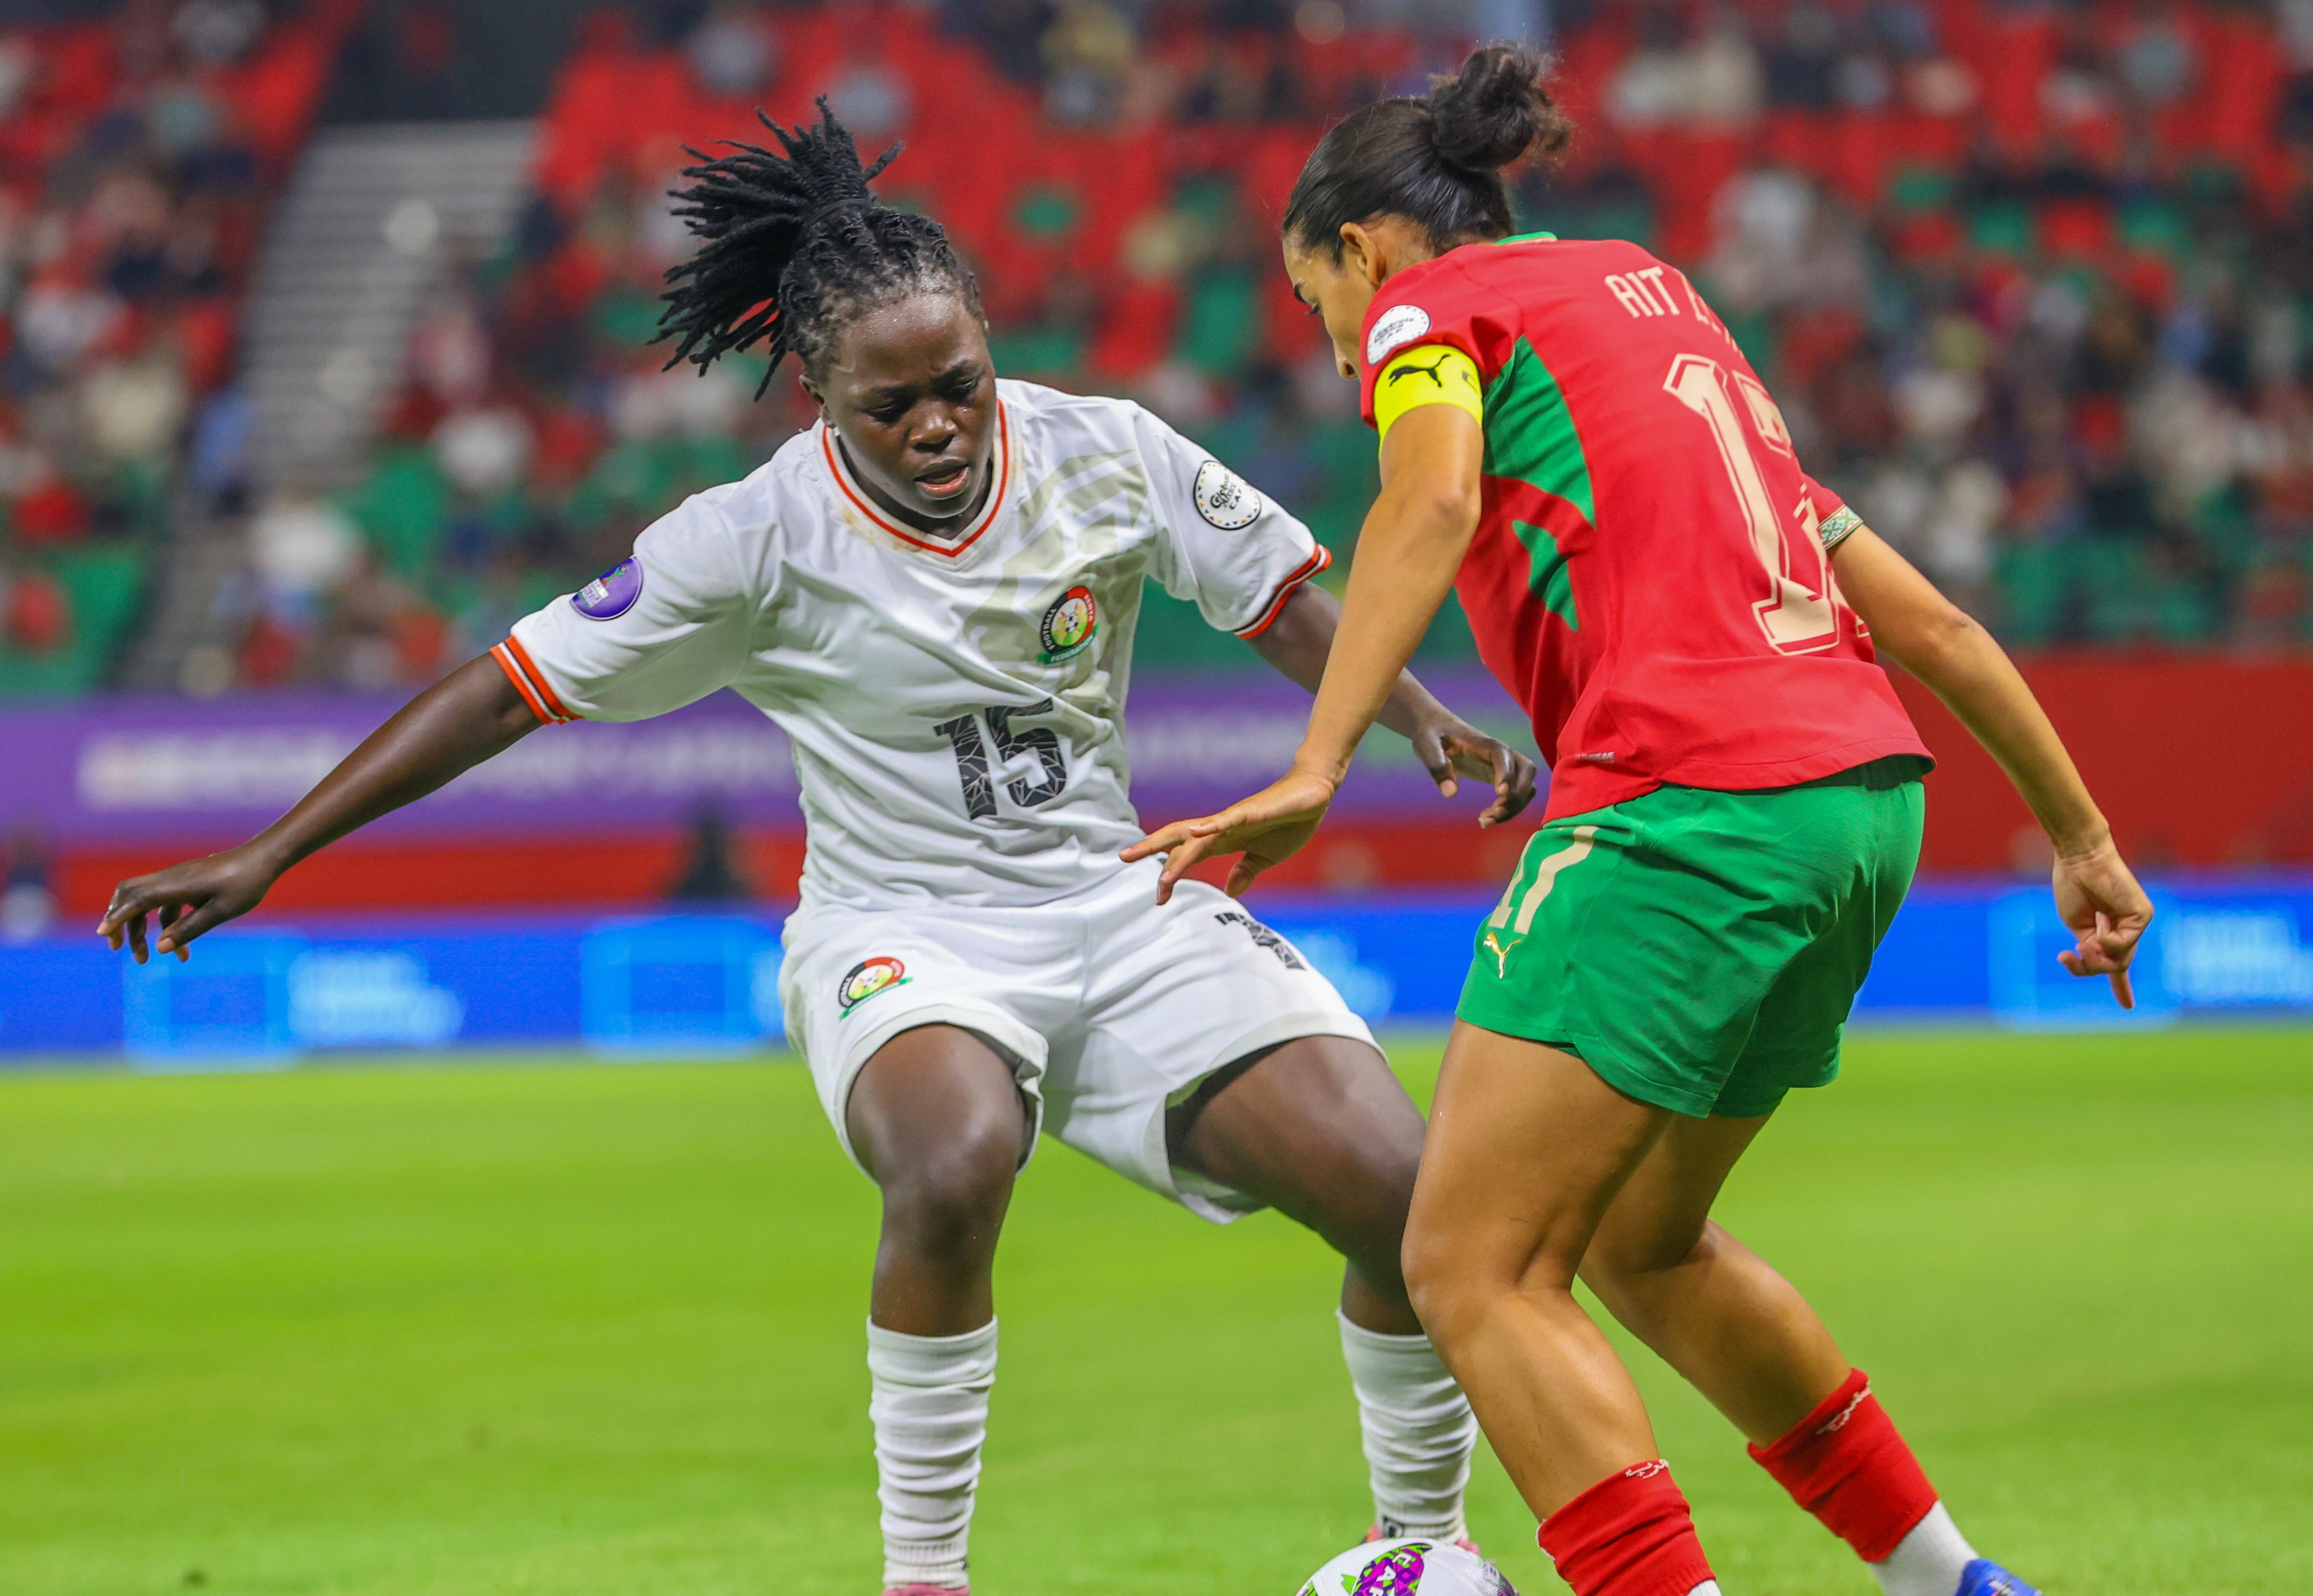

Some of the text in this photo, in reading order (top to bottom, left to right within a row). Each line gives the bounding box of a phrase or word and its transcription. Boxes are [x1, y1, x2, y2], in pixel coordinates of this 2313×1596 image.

[1605, 266, 1680, 318] AIT
[1229, 488, 1242, 509] CAF
[1043, 608, 1057, 650] FOOTBALL
[933, 697, 1067, 820] 15
